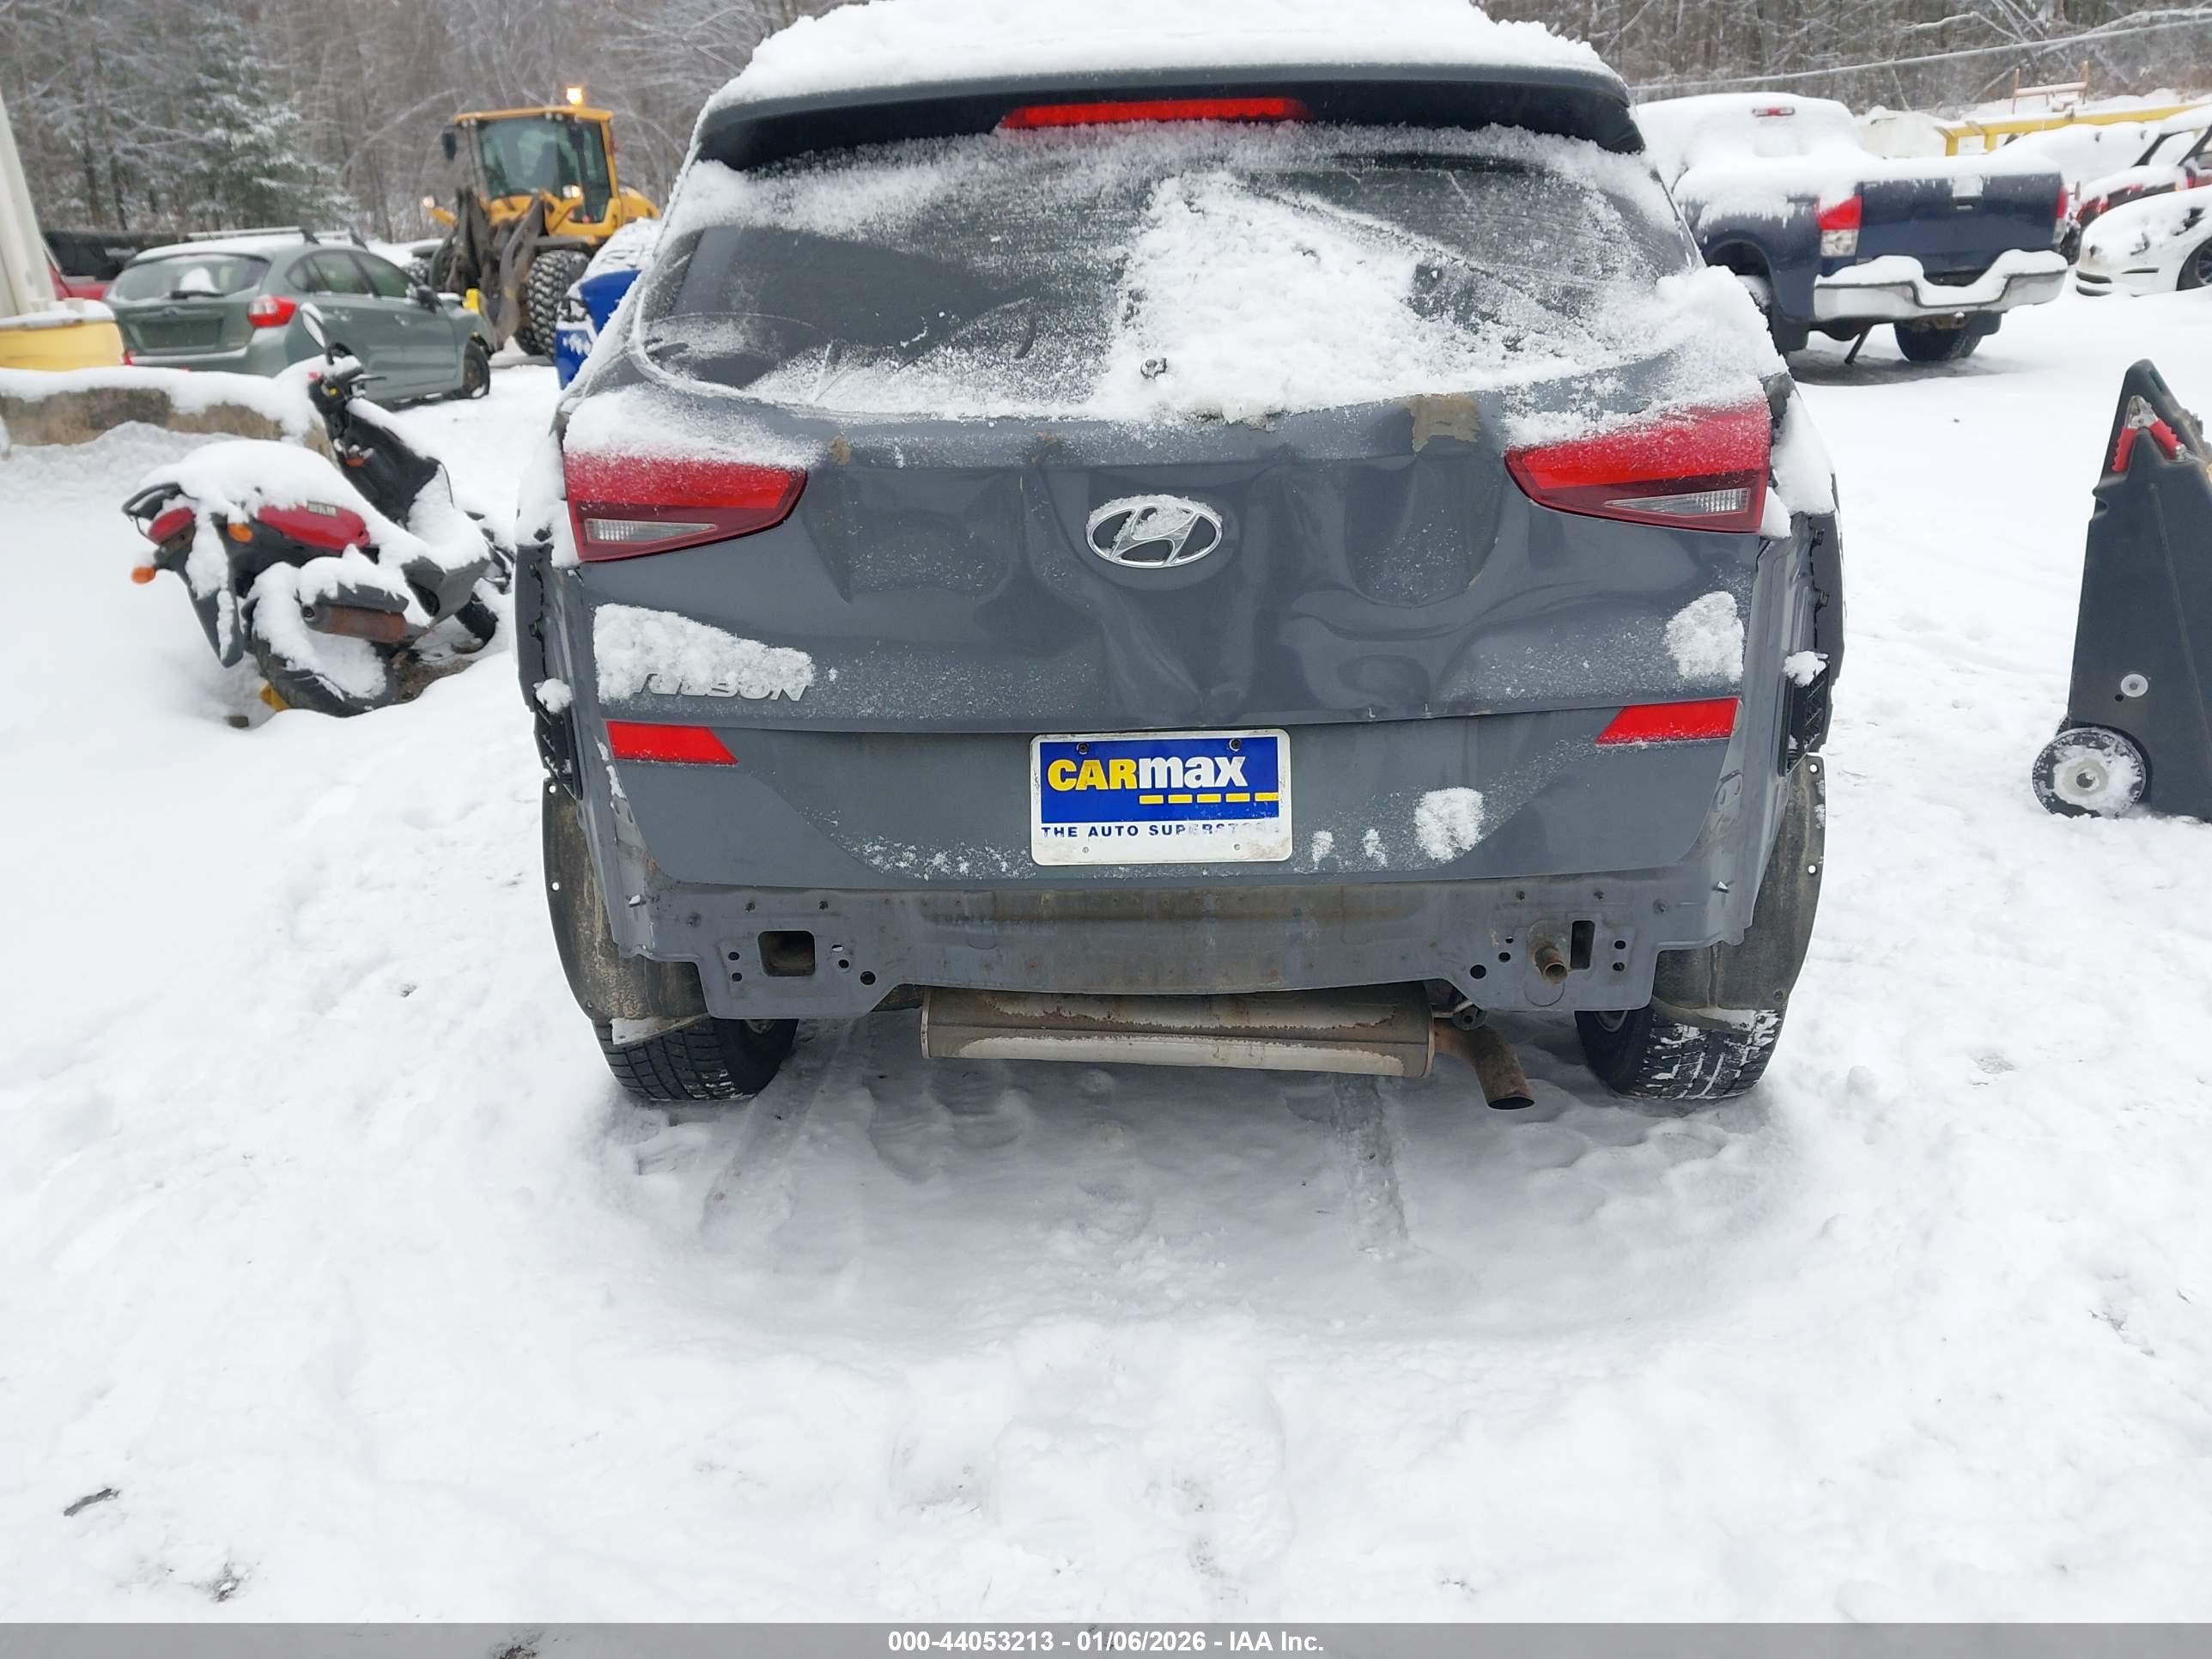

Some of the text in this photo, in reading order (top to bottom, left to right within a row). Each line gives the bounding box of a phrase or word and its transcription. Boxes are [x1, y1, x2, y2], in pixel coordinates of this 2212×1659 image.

[1047, 756, 1249, 792] CARmax
[1041, 826, 1079, 838] THE
[1087, 824, 1139, 837] AUTO
